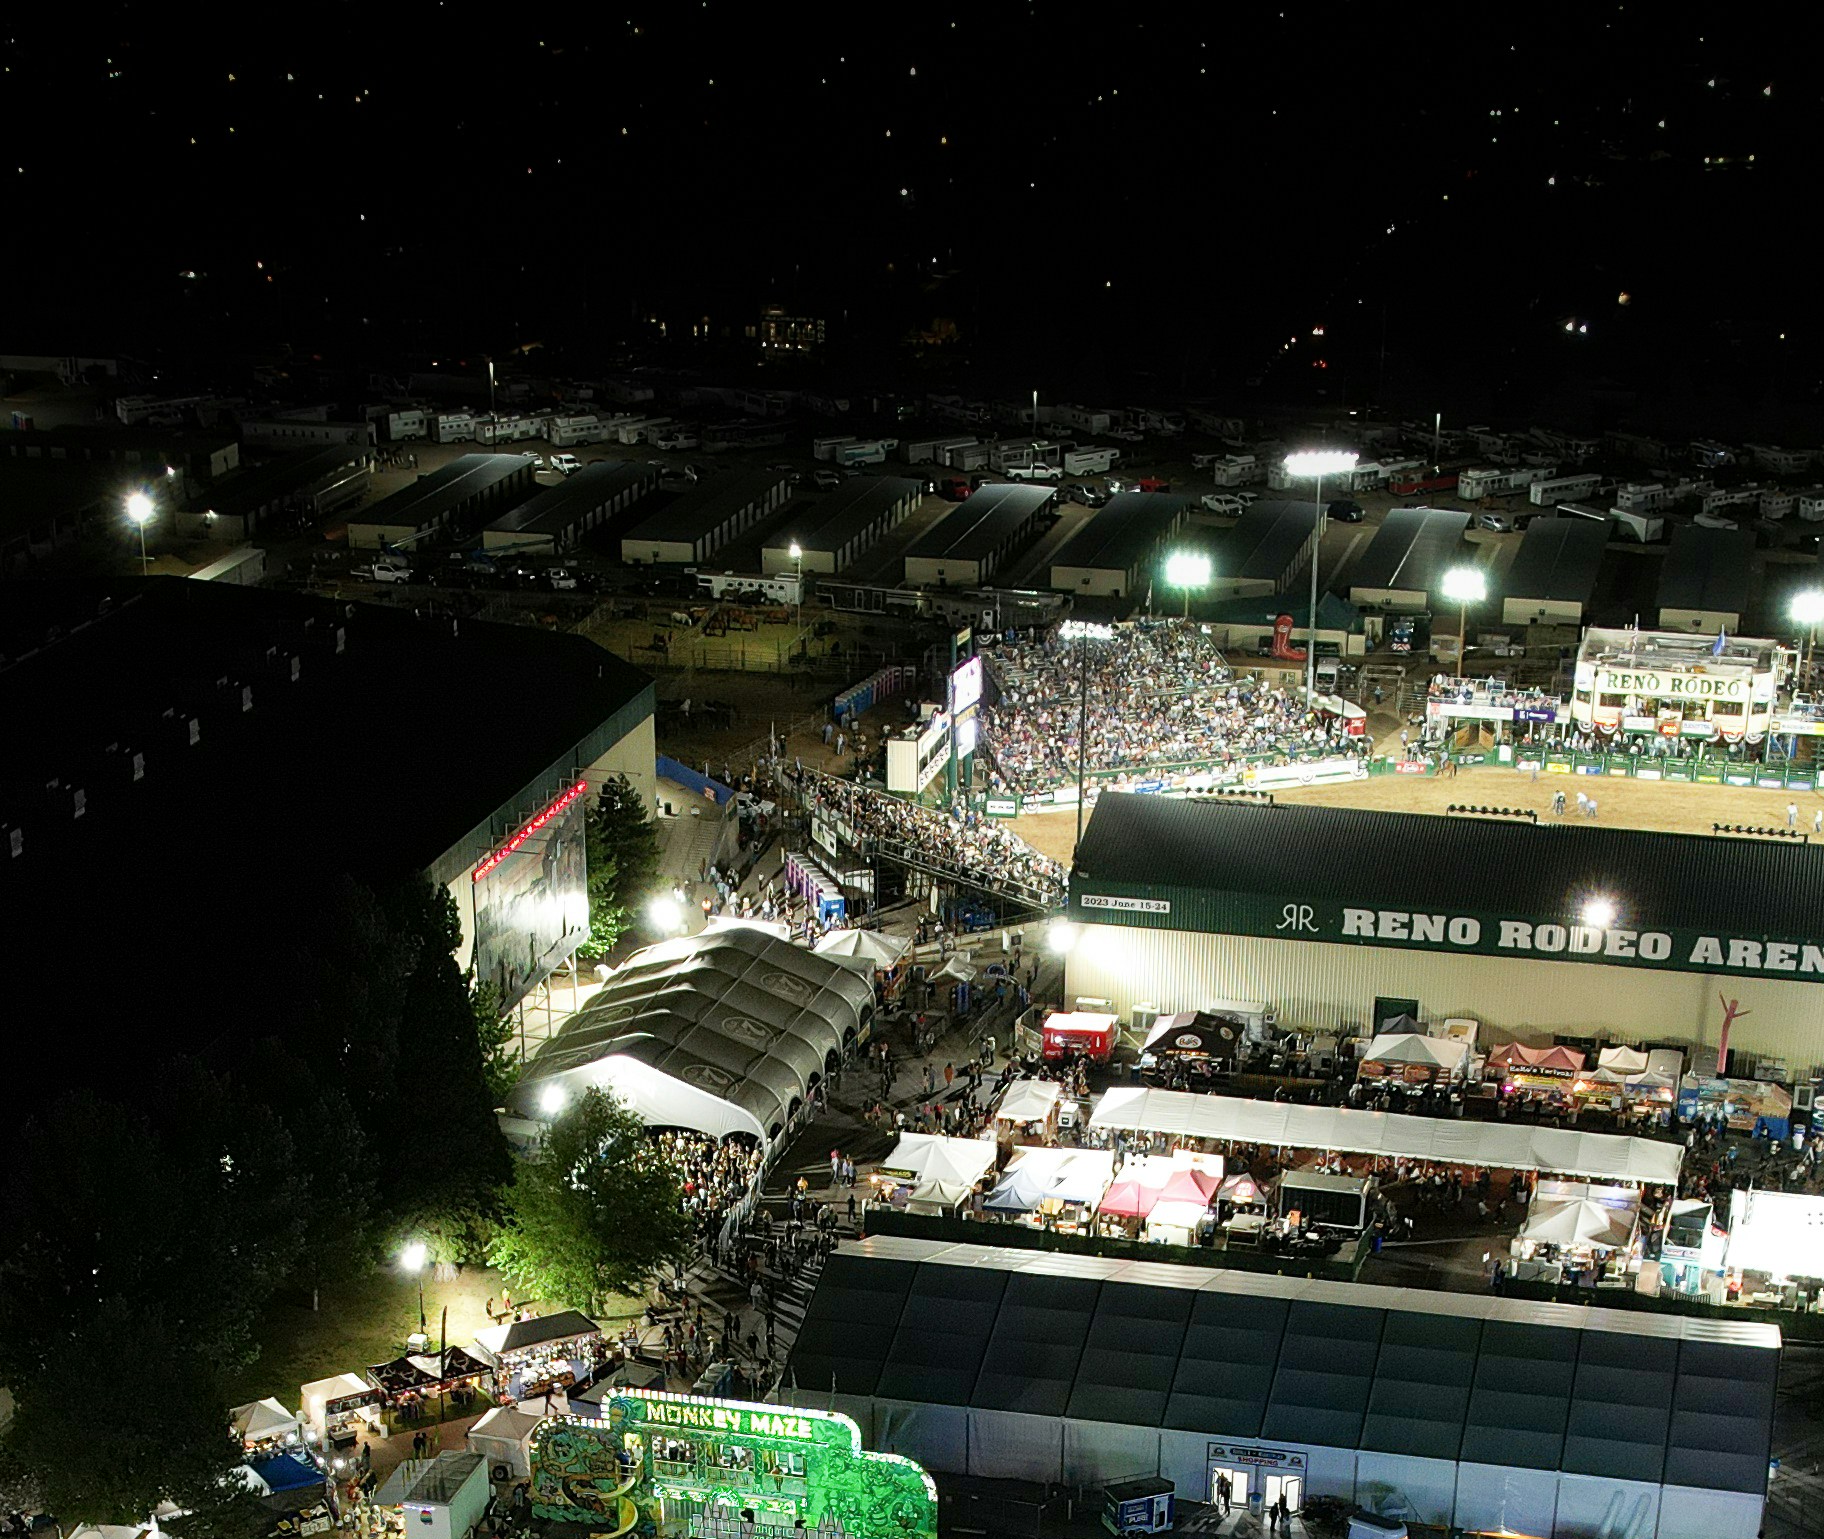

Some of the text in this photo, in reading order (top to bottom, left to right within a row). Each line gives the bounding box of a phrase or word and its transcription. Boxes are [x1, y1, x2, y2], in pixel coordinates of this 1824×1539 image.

[1607, 673, 1739, 696] RENO RODEO
[1112, 899, 1136, 908] June
[1342, 908, 1481, 946] RENO
[1498, 920, 1673, 961] RODEO
[646, 1401, 813, 1438] MONKEY MAZE
